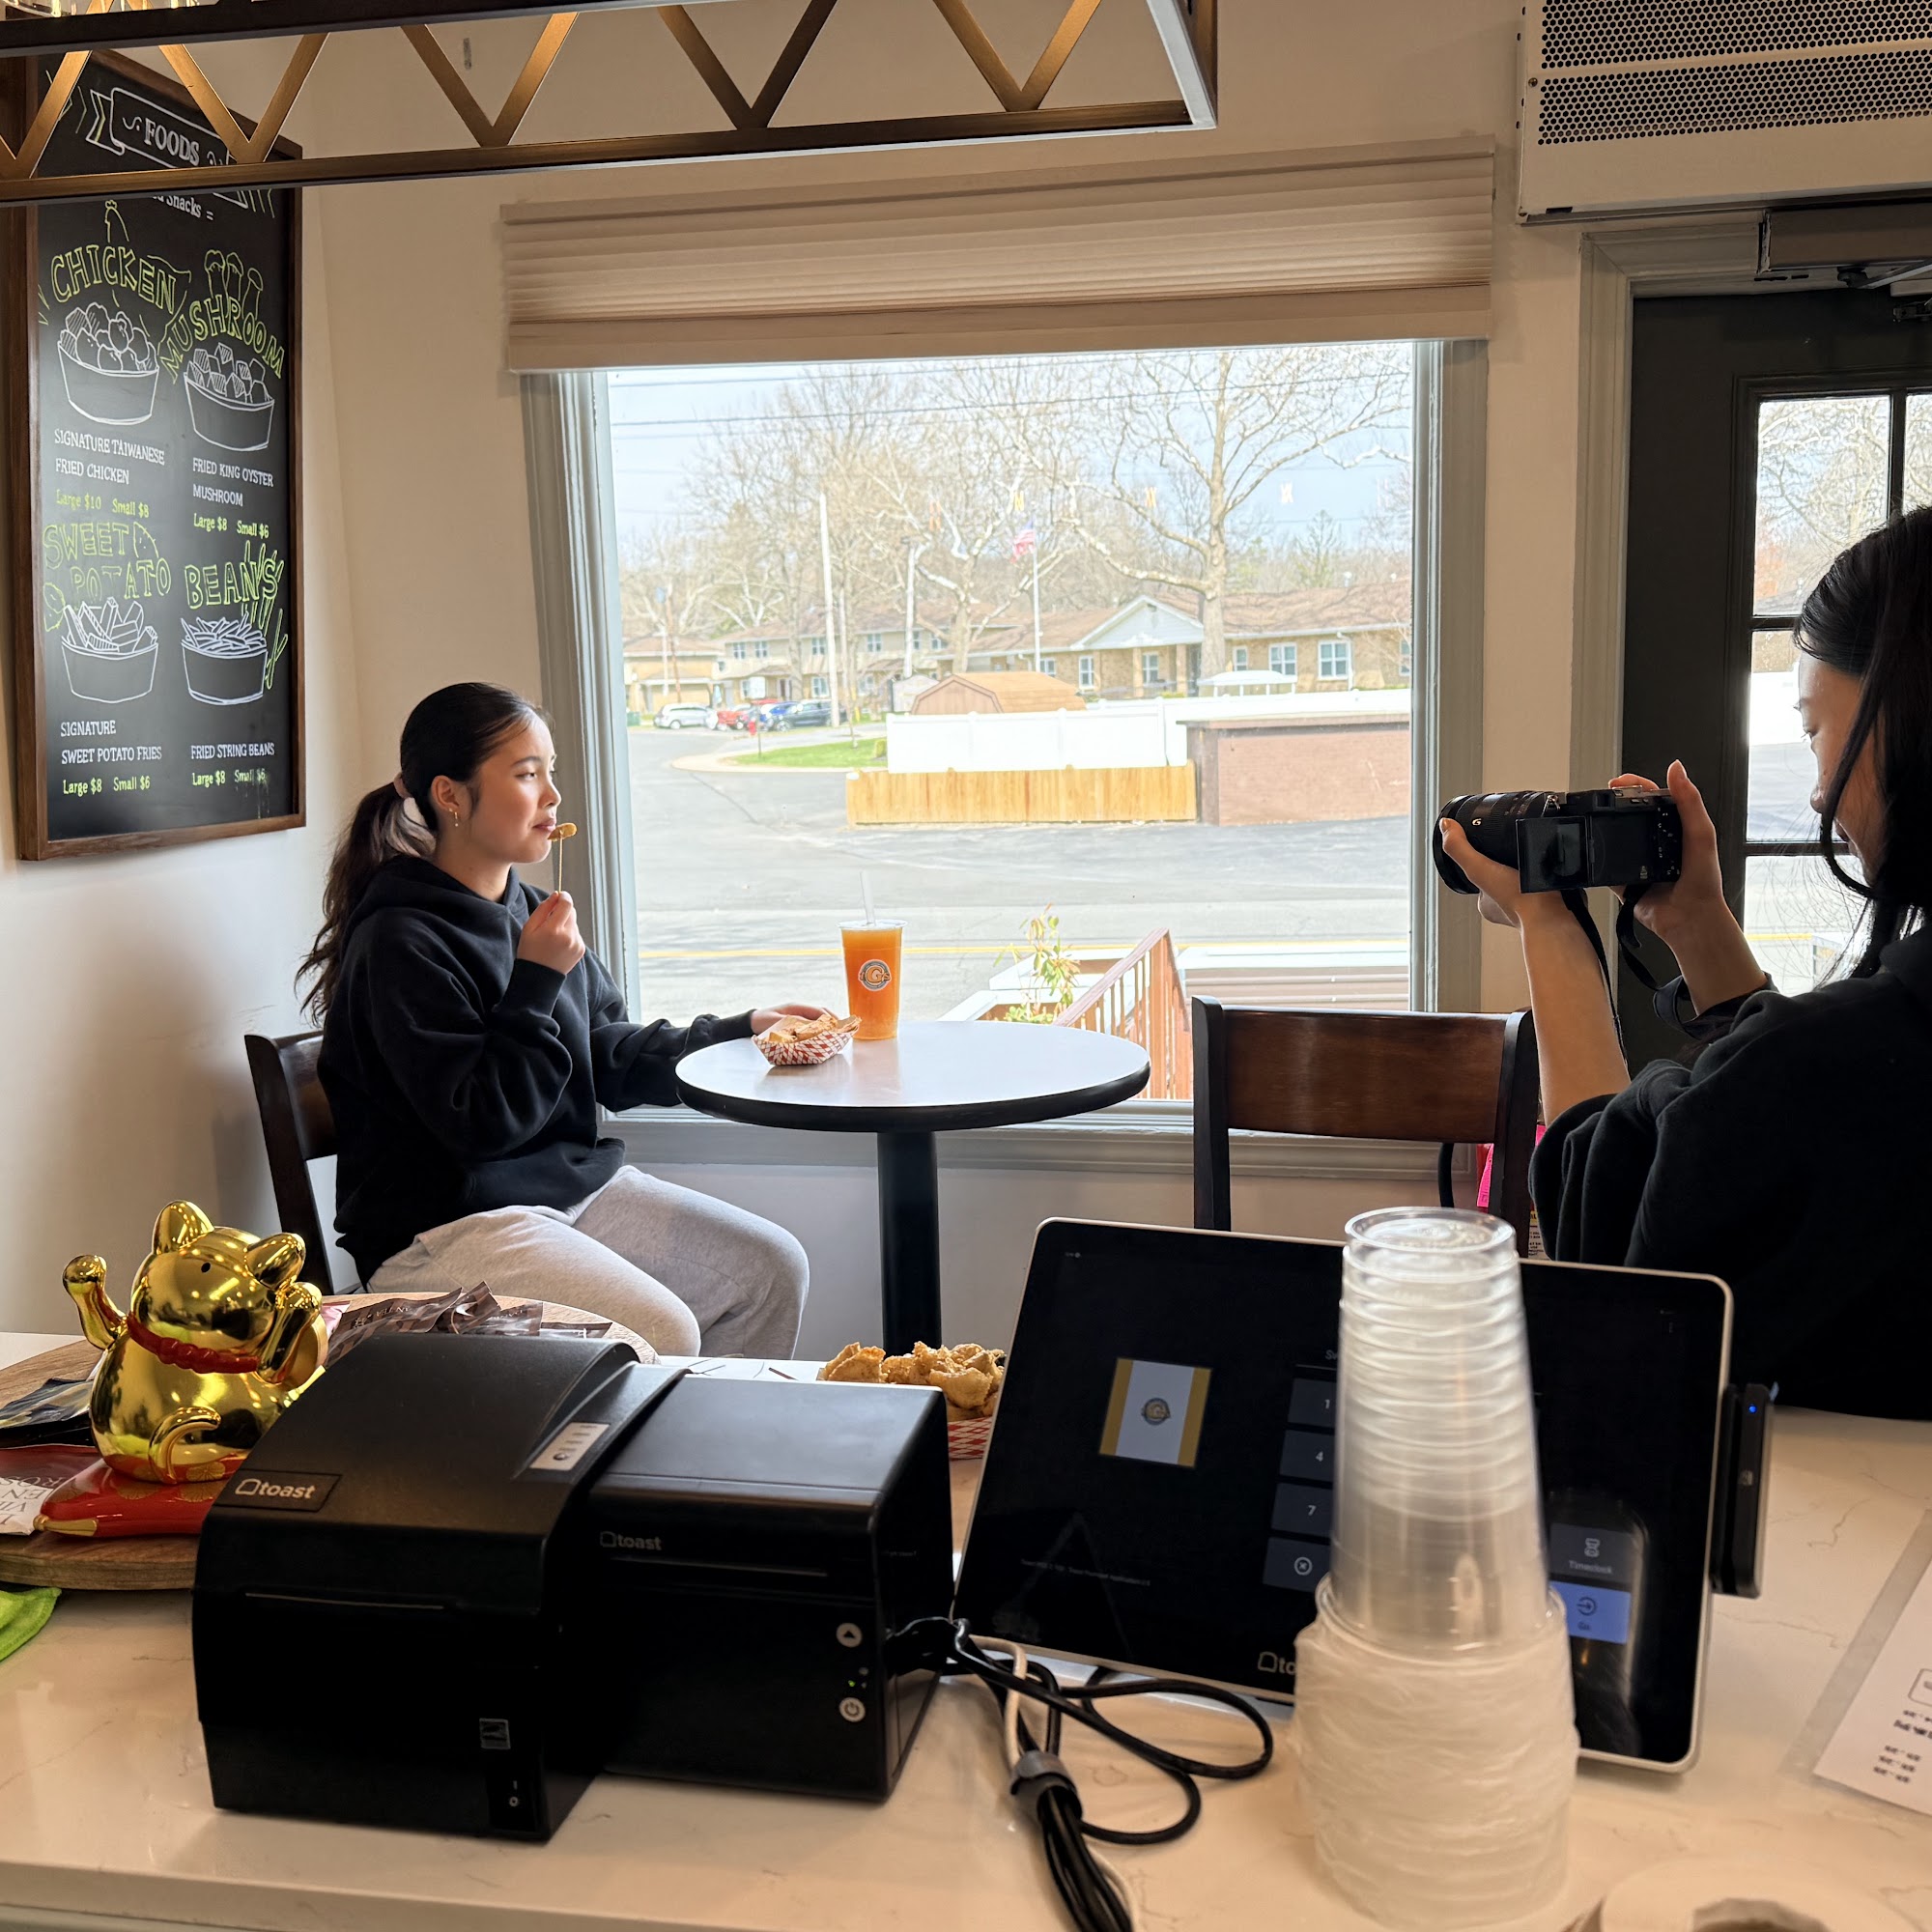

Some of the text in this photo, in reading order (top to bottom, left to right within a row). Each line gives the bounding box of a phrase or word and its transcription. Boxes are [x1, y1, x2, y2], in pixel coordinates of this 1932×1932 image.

[144, 119, 200, 166] FOODS
[50, 244, 176, 315] CHICKEN
[159, 294, 285, 385] MUSHROOM
[54, 428, 165, 466] SIGNATURE TAIWANESE
[55, 458, 129, 485] FRIED CHICKEN
[192, 457, 274, 488] FRIED KING OYSTER
[56, 489, 150, 519] Large $10 Small $8
[192, 483, 243, 507] MUSHROOM
[193, 512, 270, 539] Large $8 Small $6
[43, 522, 129, 570] SWEET
[70, 557, 172, 611] POTATO
[184, 558, 278, 610] BEANS
[60, 720, 117, 737] SIGNATURE
[61, 746, 162, 765] SWEET POTATO FRIES
[190, 742, 275, 760] FRIED STRING BEANS
[63, 775, 151, 797] Large $8 Small $6
[192, 772, 214, 788] Large
[214, 769, 226, 786] $8
[1325, 1399, 1331, 1409] 1
[1315, 1451, 1324, 1463] 4
[258, 1481, 316, 1499] toast
[1308, 1504, 1318, 1517] 7
[617, 1533, 663, 1551] toast
